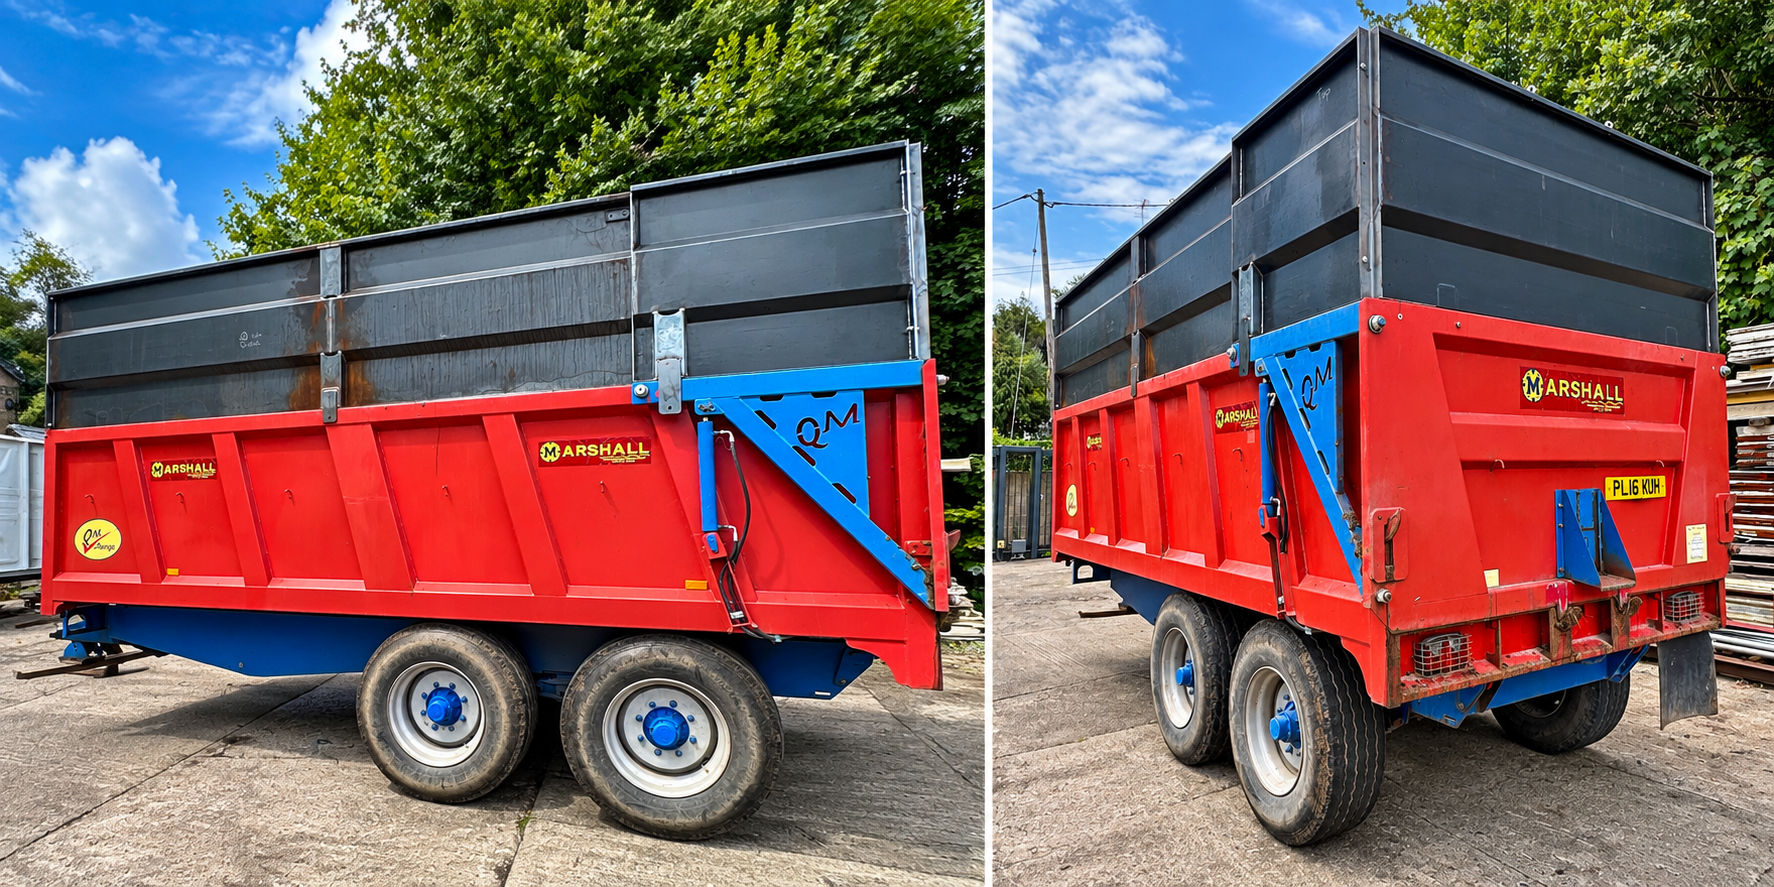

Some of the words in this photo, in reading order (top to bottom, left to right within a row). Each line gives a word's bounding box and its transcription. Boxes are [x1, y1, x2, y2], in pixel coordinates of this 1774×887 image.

[1302, 355, 1333, 411] QM
[1522, 368, 1624, 402] MARSHALL
[796, 402, 860, 449] QM
[540, 441, 650, 463] MARSHALL
[151, 461, 216, 478] MARSHALL
[1613, 479, 1639, 496] PL16
[1641, 478, 1660, 495] KUH
